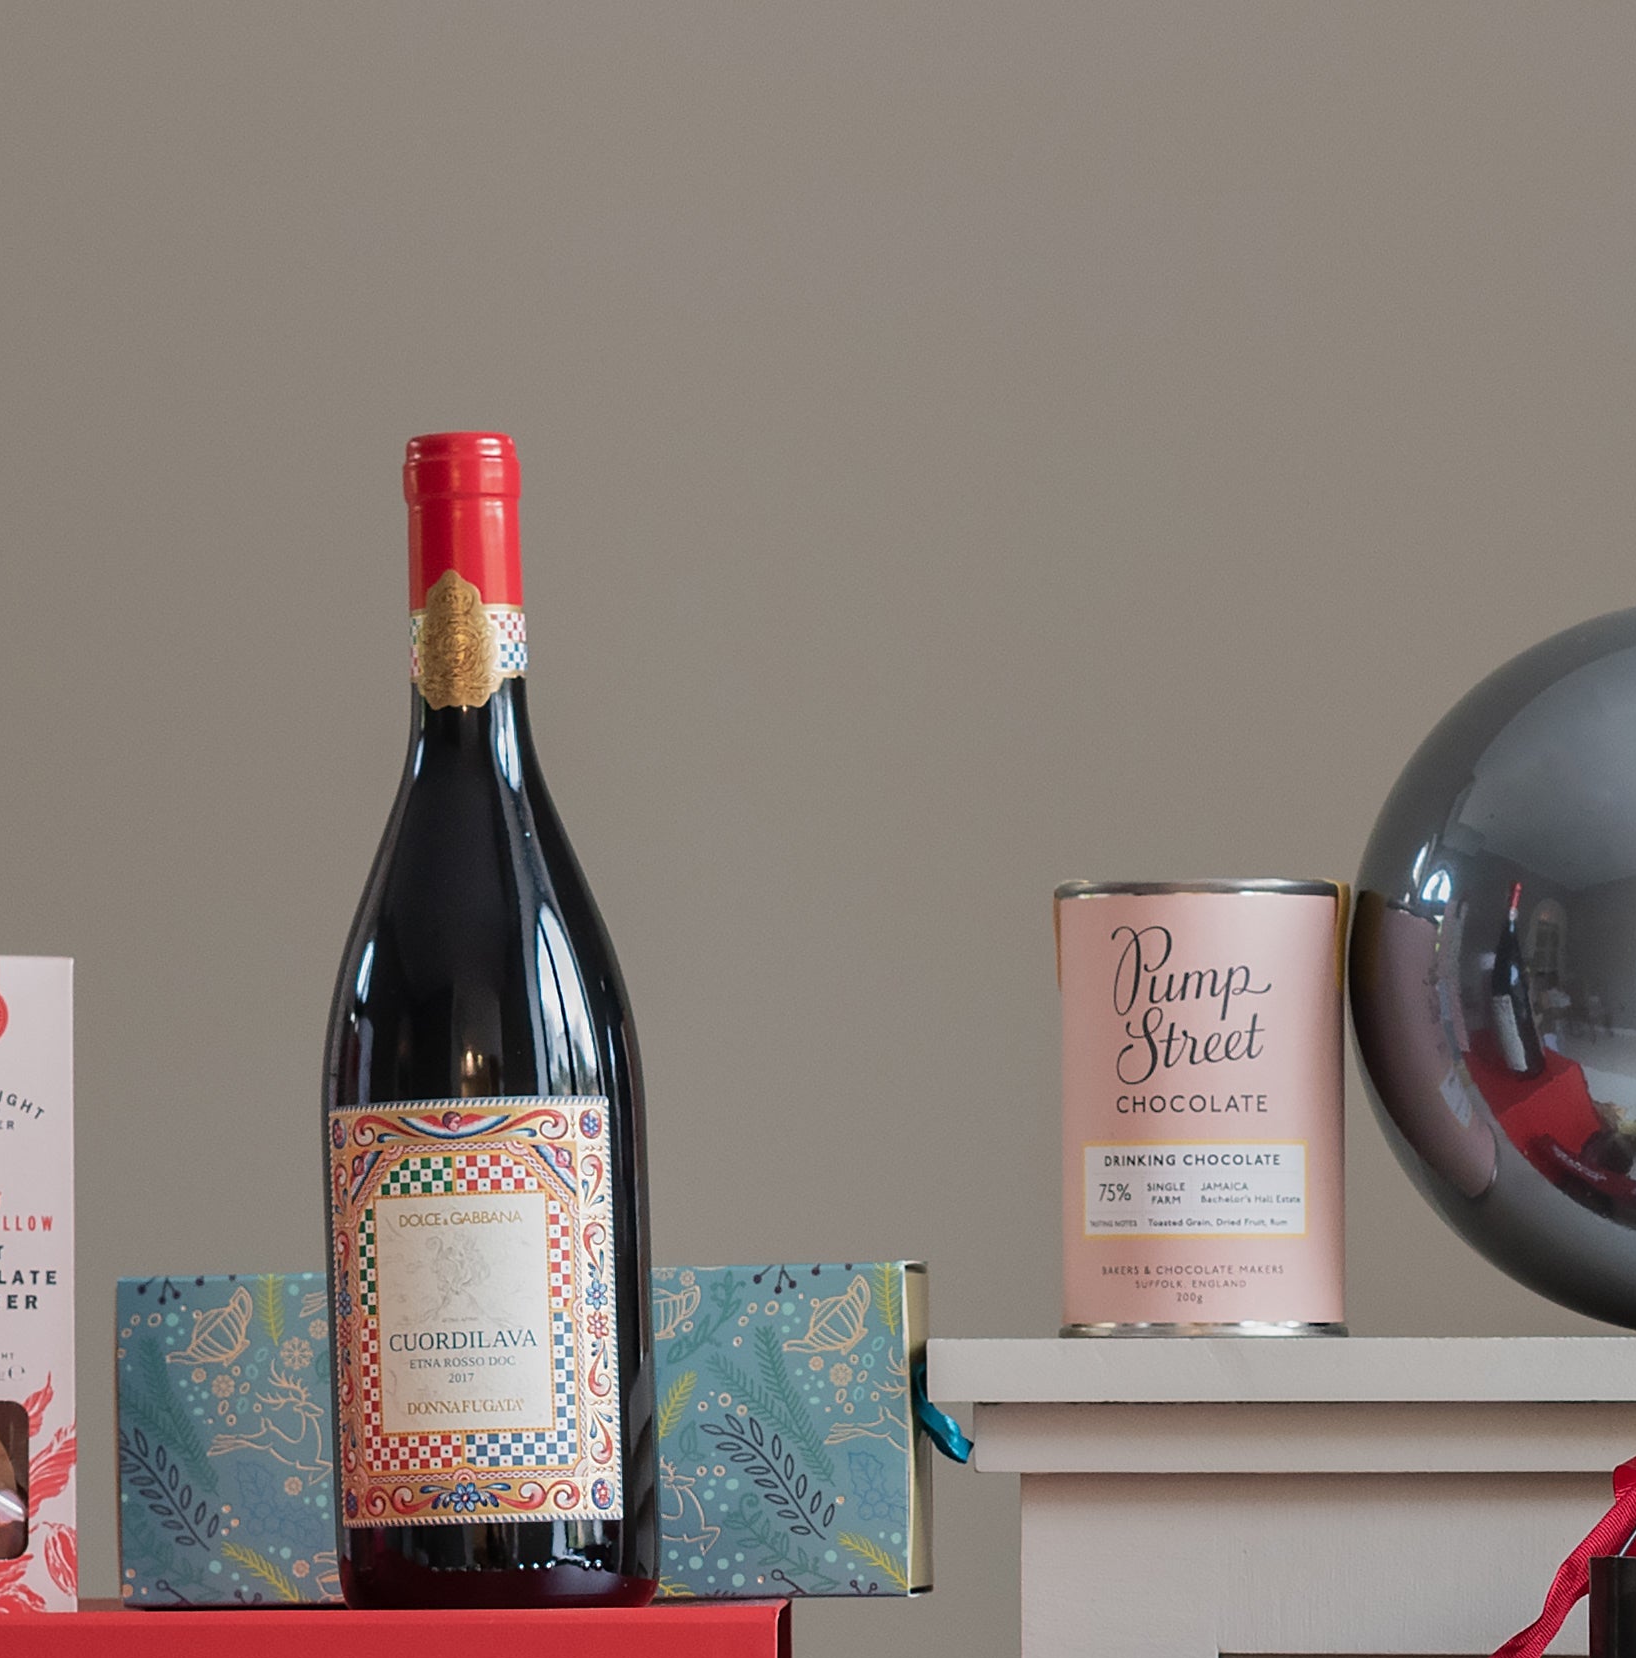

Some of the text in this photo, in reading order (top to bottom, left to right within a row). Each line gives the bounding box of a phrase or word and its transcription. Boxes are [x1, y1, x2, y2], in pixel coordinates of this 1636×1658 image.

[1111, 925, 1272, 1021] Pump
[1115, 1006, 1265, 1086] Street
[1116, 1095, 1268, 1113] CHOCOLATE
[1104, 1154, 1280, 1167] DRINKING CHOCOLATE
[1099, 1183, 1131, 1202] 75%
[1147, 1182, 1185, 1192] SINGLE
[1201, 1182, 1248, 1191] JAMAICA
[1151, 1196, 1181, 1204] FARM
[399, 1213, 441, 1227] DOLCE
[450, 1210, 522, 1226] GABBANA
[1148, 1218, 1183, 1227] Toasted
[1216, 1218, 1241, 1227] Dried
[1102, 1266, 1139, 1275] BAKERS
[1156, 1265, 1233, 1275] CHOCOLATE
[1239, 1265, 1284, 1274] MAKERS
[1192, 1279, 1247, 1288] ENGLAND
[390, 1329, 537, 1352] CUORDILAVA
[410, 1355, 515, 1369] ETNA ROSSO DOC
[448, 1373, 474, 1383] 2017
